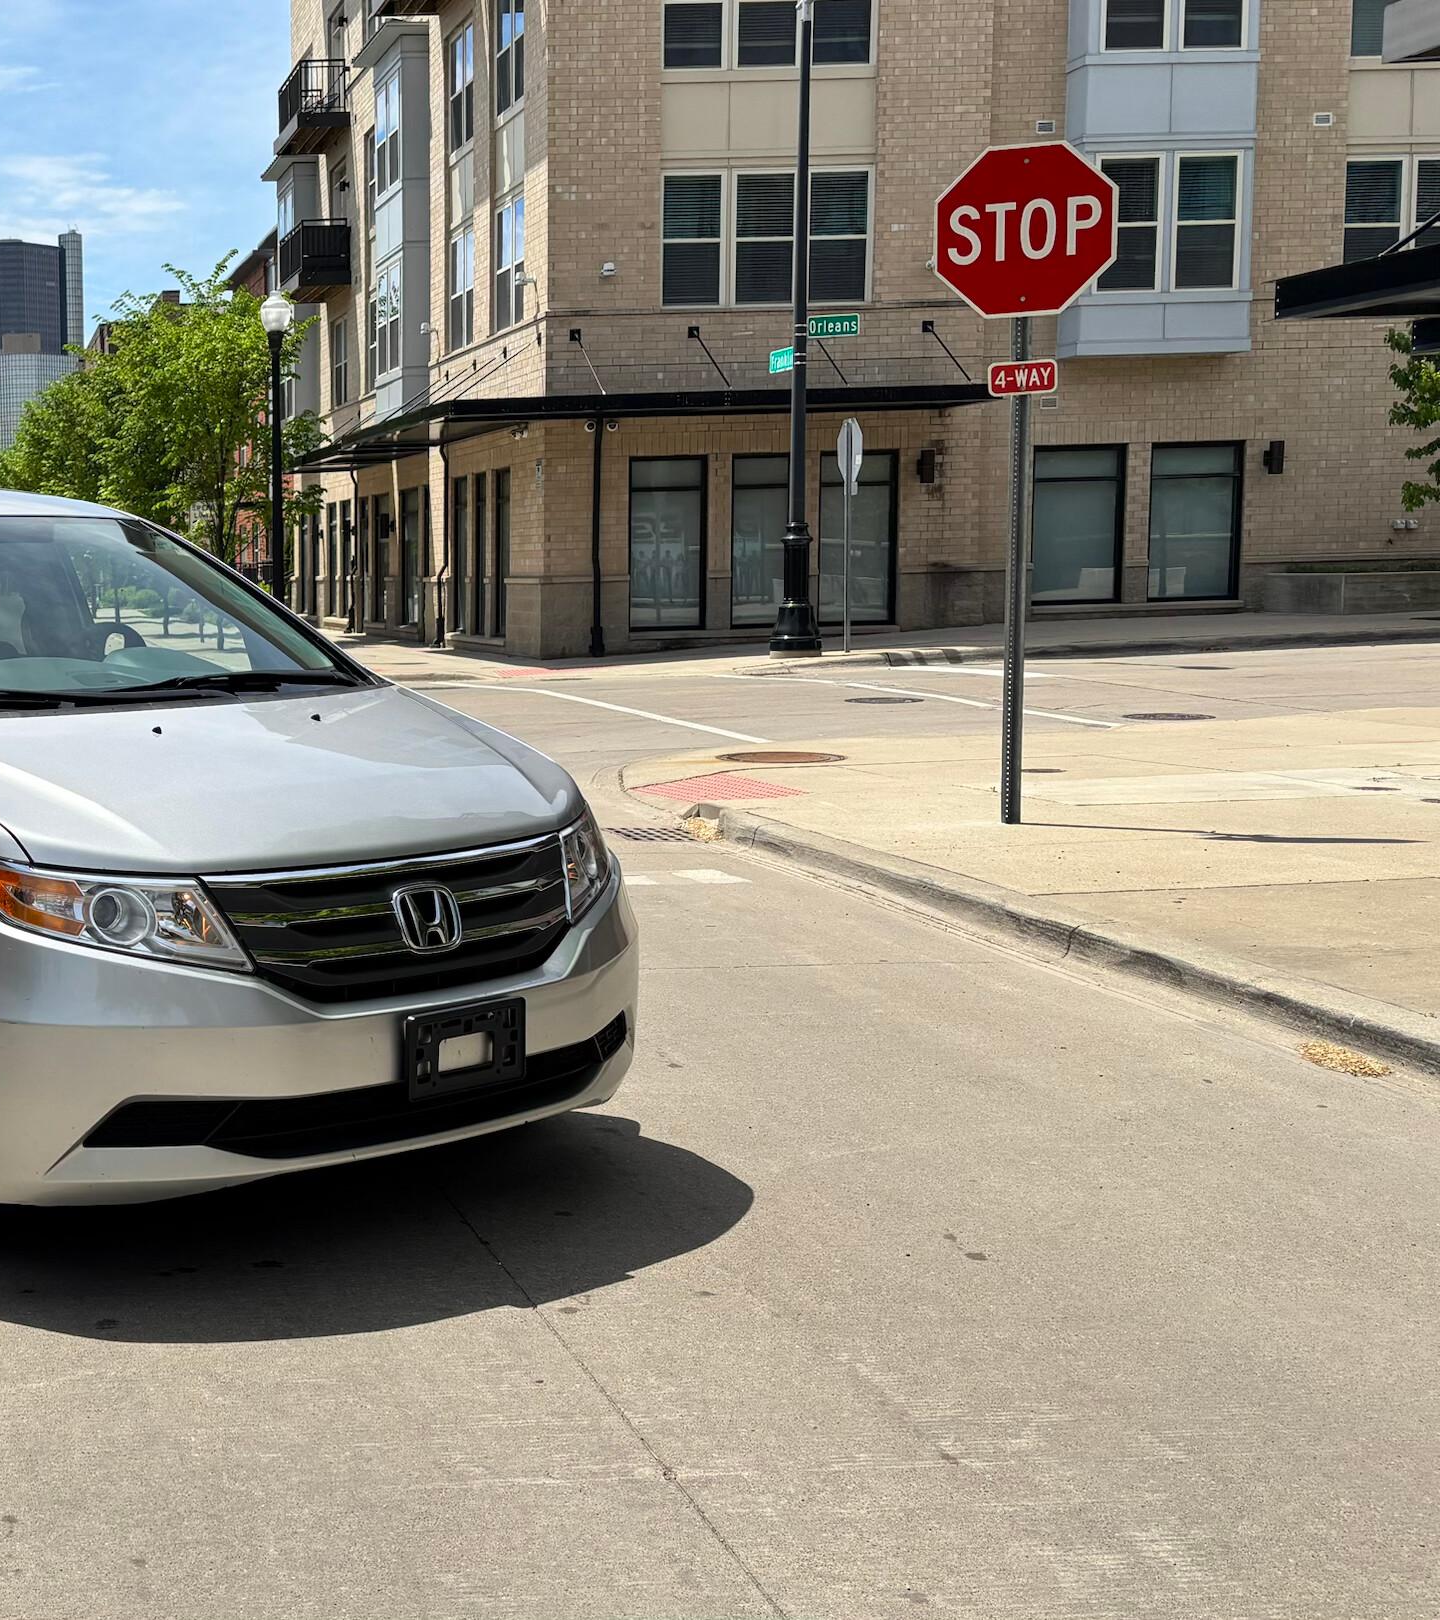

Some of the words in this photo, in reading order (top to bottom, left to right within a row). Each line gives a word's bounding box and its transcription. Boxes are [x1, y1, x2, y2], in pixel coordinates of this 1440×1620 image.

[947, 194, 1102, 266] STOP
[809, 320, 858, 334] Orleans
[994, 367, 1052, 389] 4-WAY
